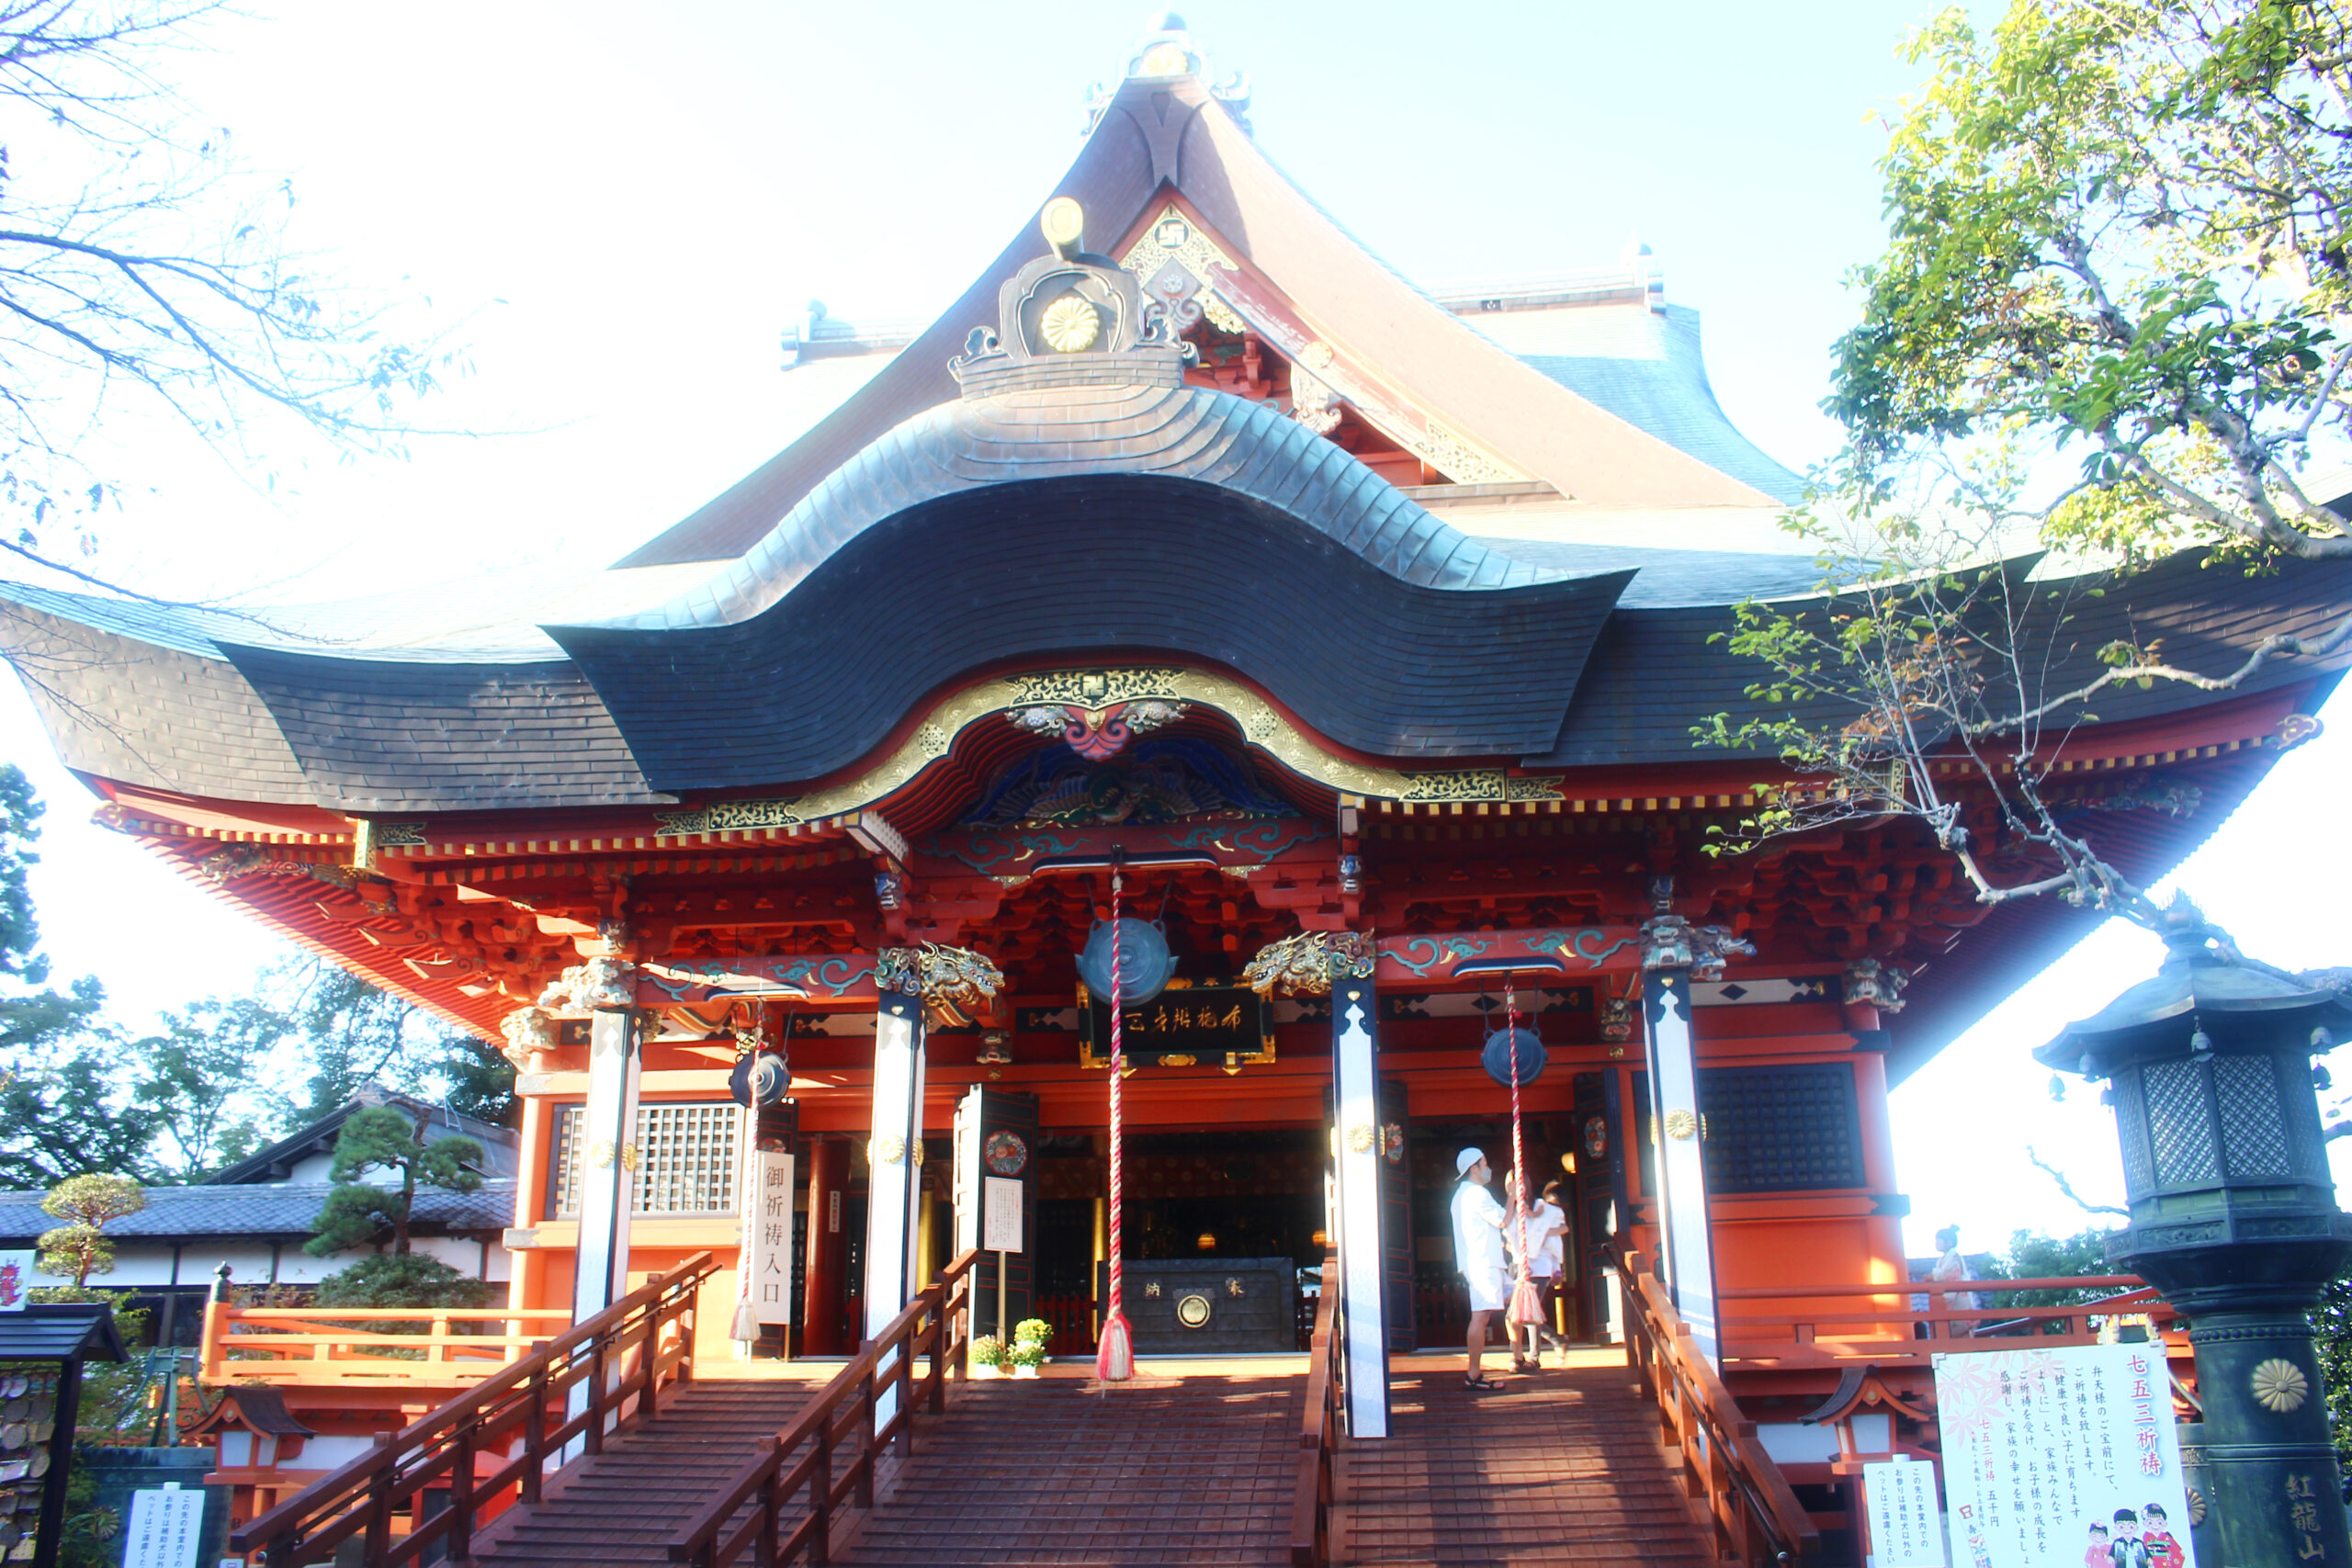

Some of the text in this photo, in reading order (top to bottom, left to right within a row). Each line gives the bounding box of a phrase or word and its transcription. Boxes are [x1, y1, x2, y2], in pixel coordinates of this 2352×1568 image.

[763, 1166, 784, 1303] 御祈祷入口
[2000, 1370, 2031, 1568] 感謝し、家族の幸せを願いましょ
[2074, 1368, 2098, 1478] ご祈祷を致します。
[2091, 1365, 2119, 1491] 弁天様のご宝前にて、
[2126, 1354, 2162, 1476] 七五三祈祷
[139, 1495, 156, 1568] ペットはご遠慮くだ
[1987, 1490, 1999, 1528] 五千円
[2286, 1473, 2325, 1561] 紅龍山
